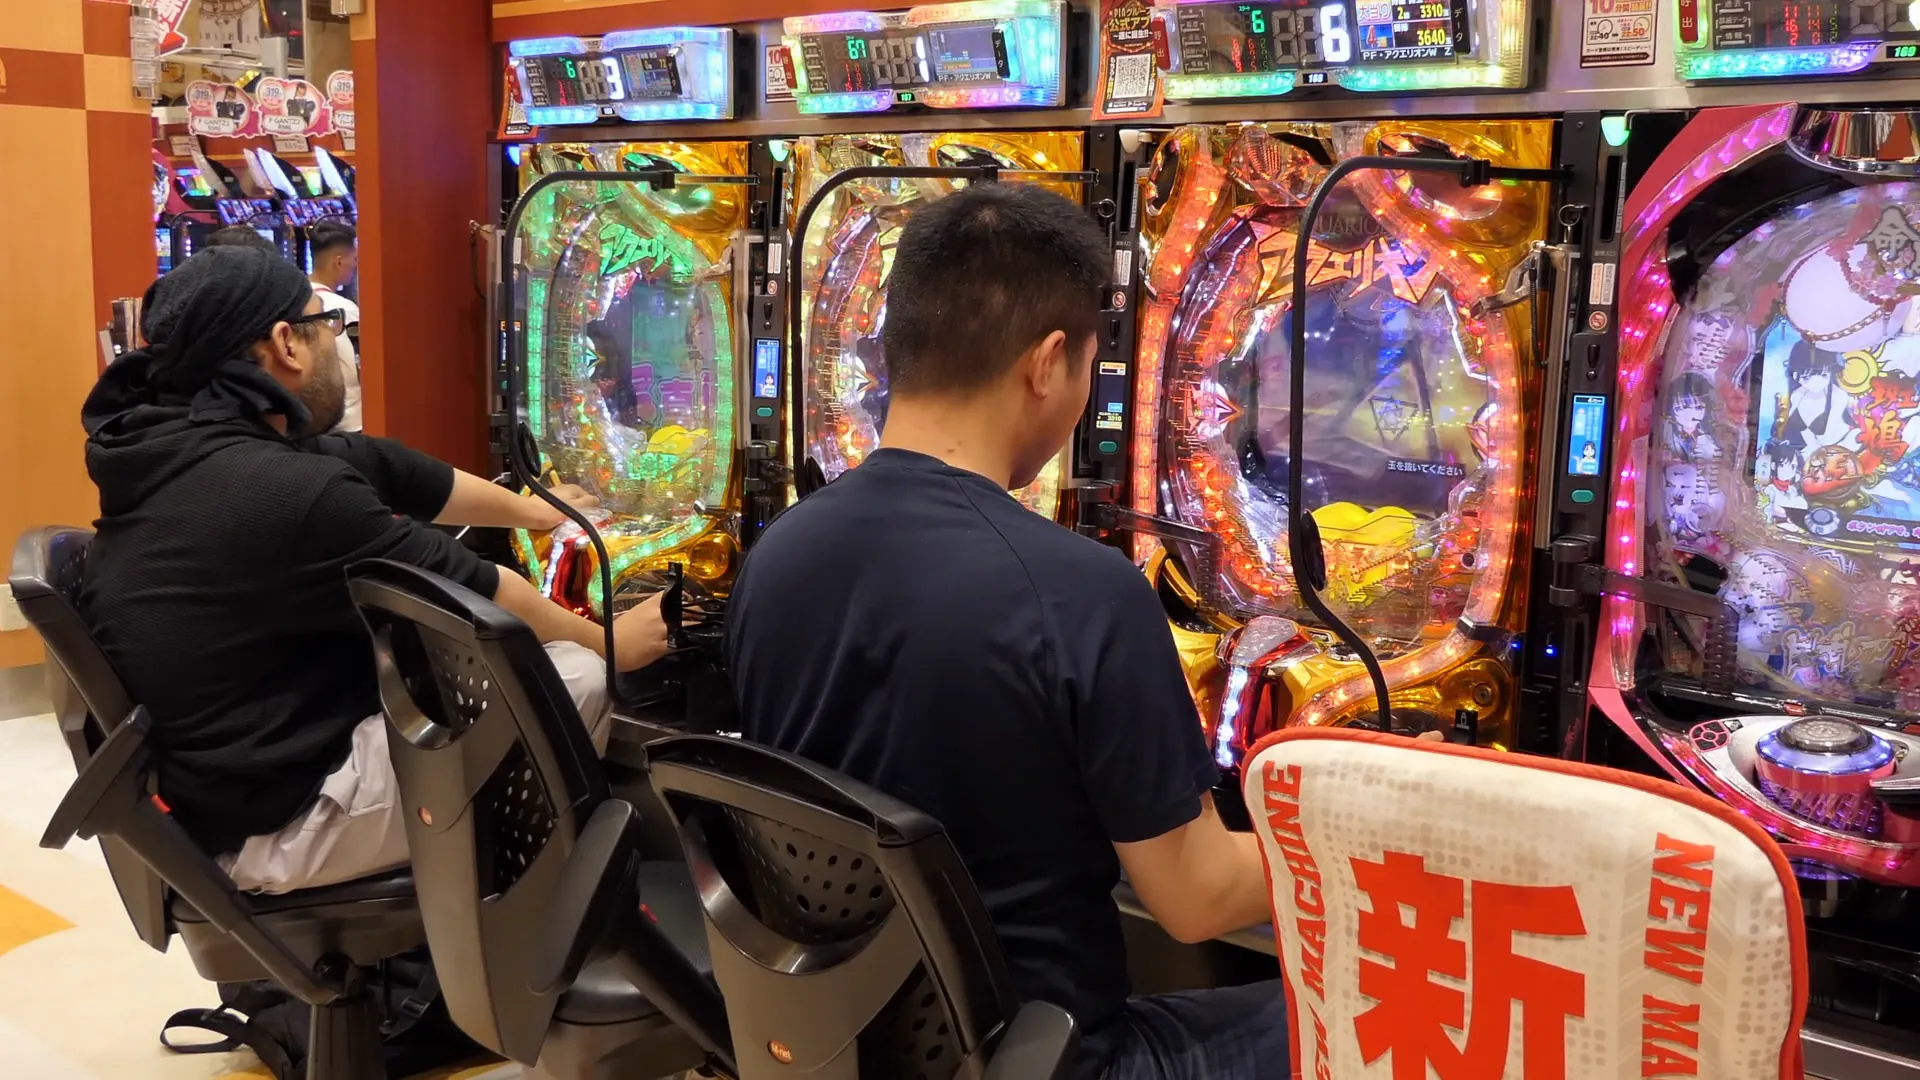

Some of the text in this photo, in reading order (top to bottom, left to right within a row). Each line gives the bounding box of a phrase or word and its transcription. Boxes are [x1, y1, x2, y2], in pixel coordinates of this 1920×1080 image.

[1251, 9, 1265, 33] 6
[1320, 3, 1351, 63] 6
[1360, 4, 1390, 20] 大当り
[1453, 7, 1464, 42] データ
[1387, 459, 1463, 476] 玉を抜いてください
[1262, 760, 1333, 1080] MACHINE EW
[1643, 832, 1716, 985] NEW
[1348, 850, 1588, 1080] 新
